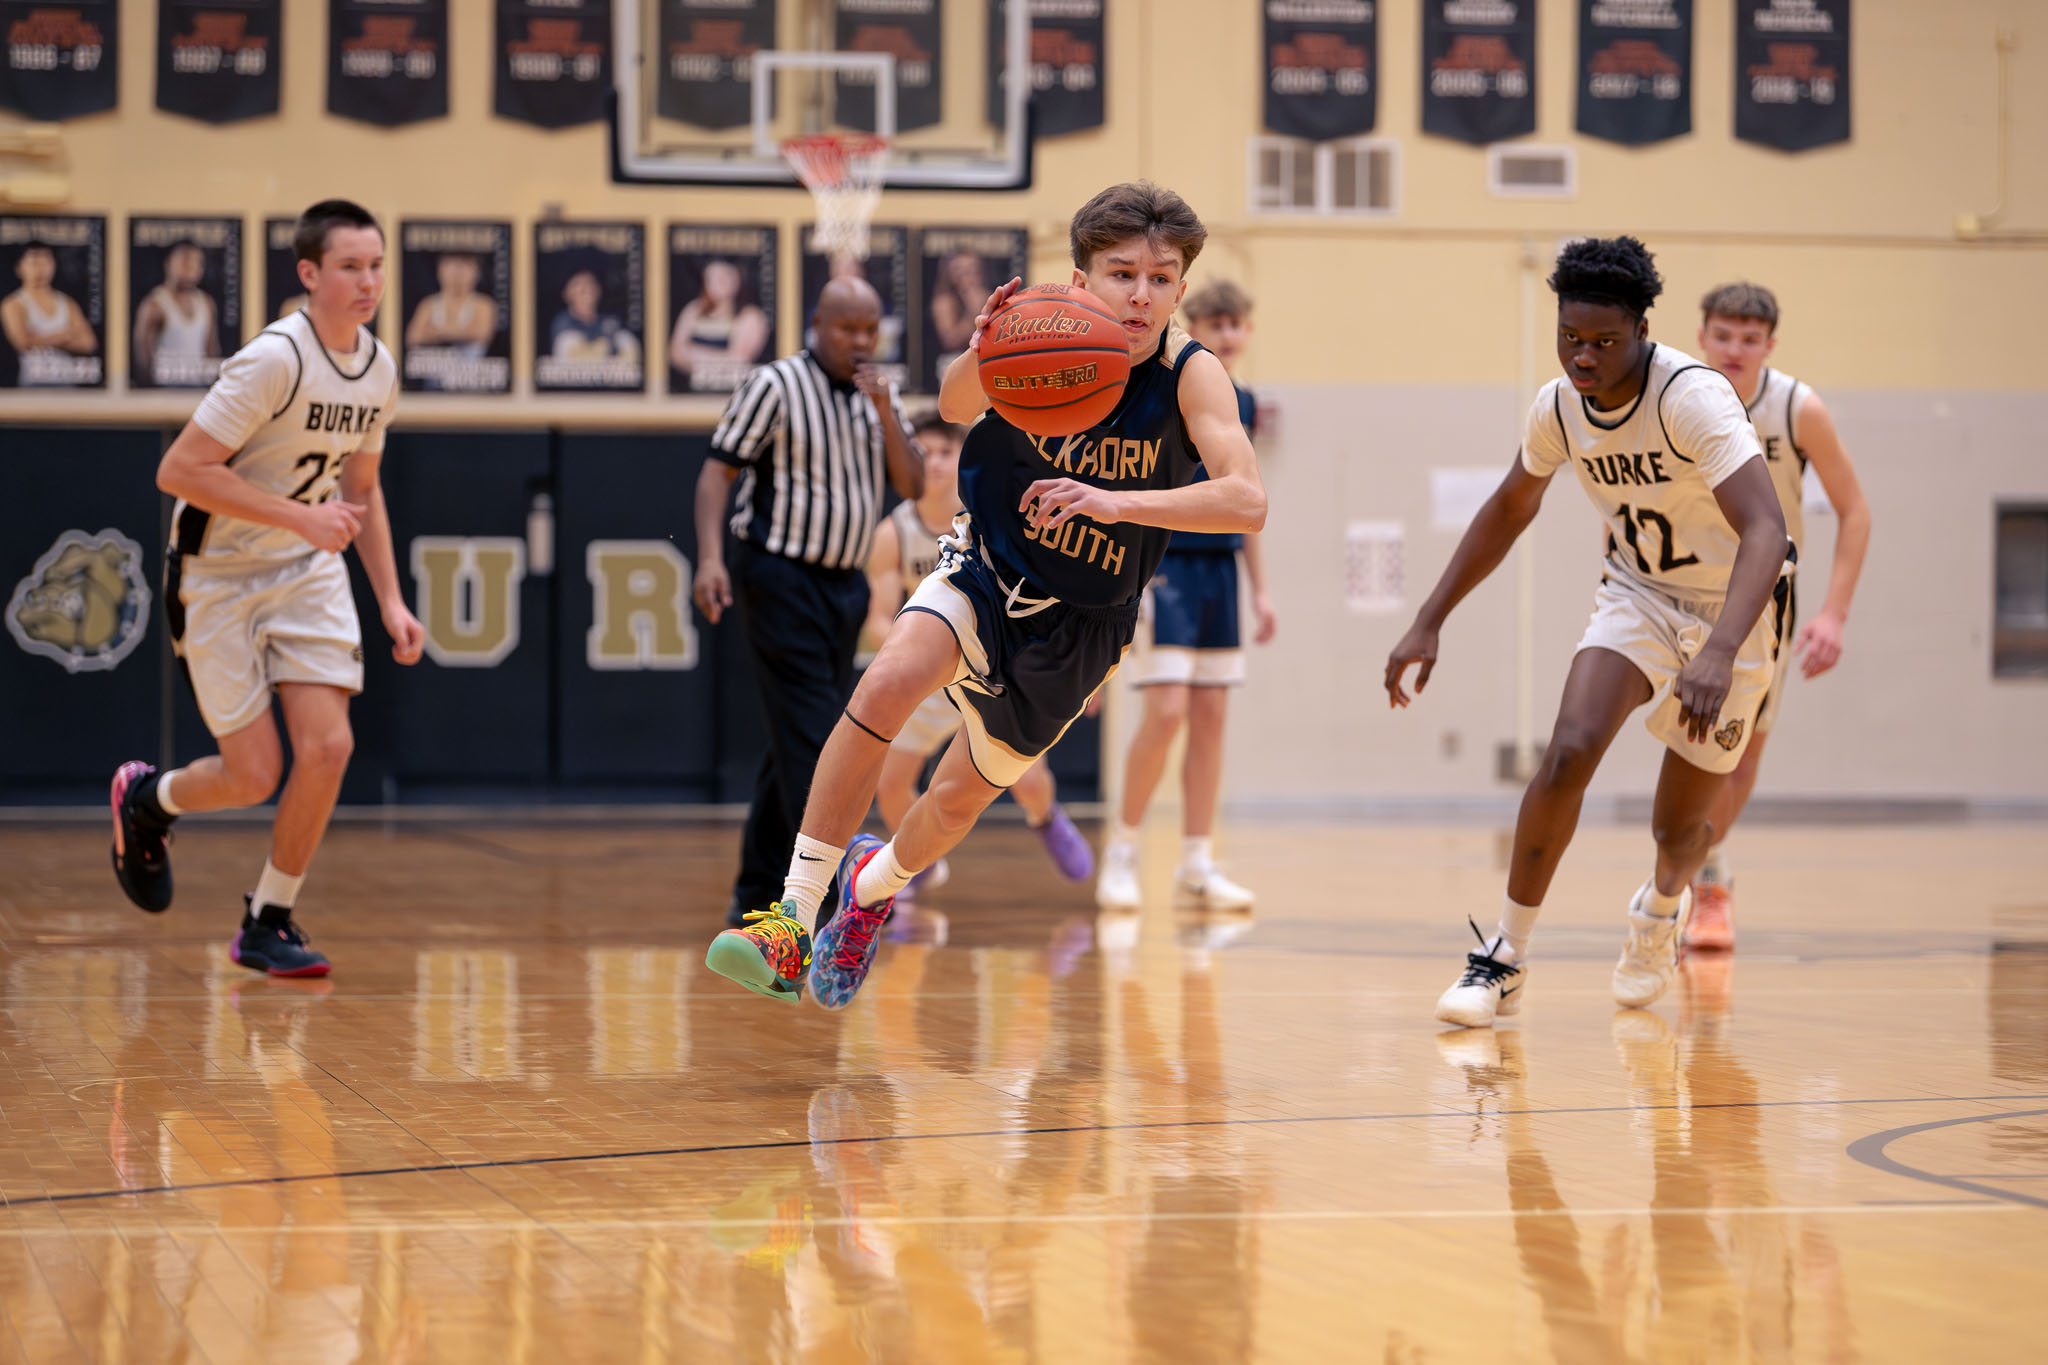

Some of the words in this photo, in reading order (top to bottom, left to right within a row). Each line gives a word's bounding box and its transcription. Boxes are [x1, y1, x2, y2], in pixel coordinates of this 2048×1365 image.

[994, 309, 1092, 344] Baden
[305, 402, 381, 433] BURKE
[1026, 431, 1162, 480] LKHORN
[1580, 451, 1673, 486] BURKE
[1023, 503, 1126, 575] SOUTH
[1614, 503, 1702, 575] 12
[410, 535, 527, 668] U
[586, 539, 700, 671] R
